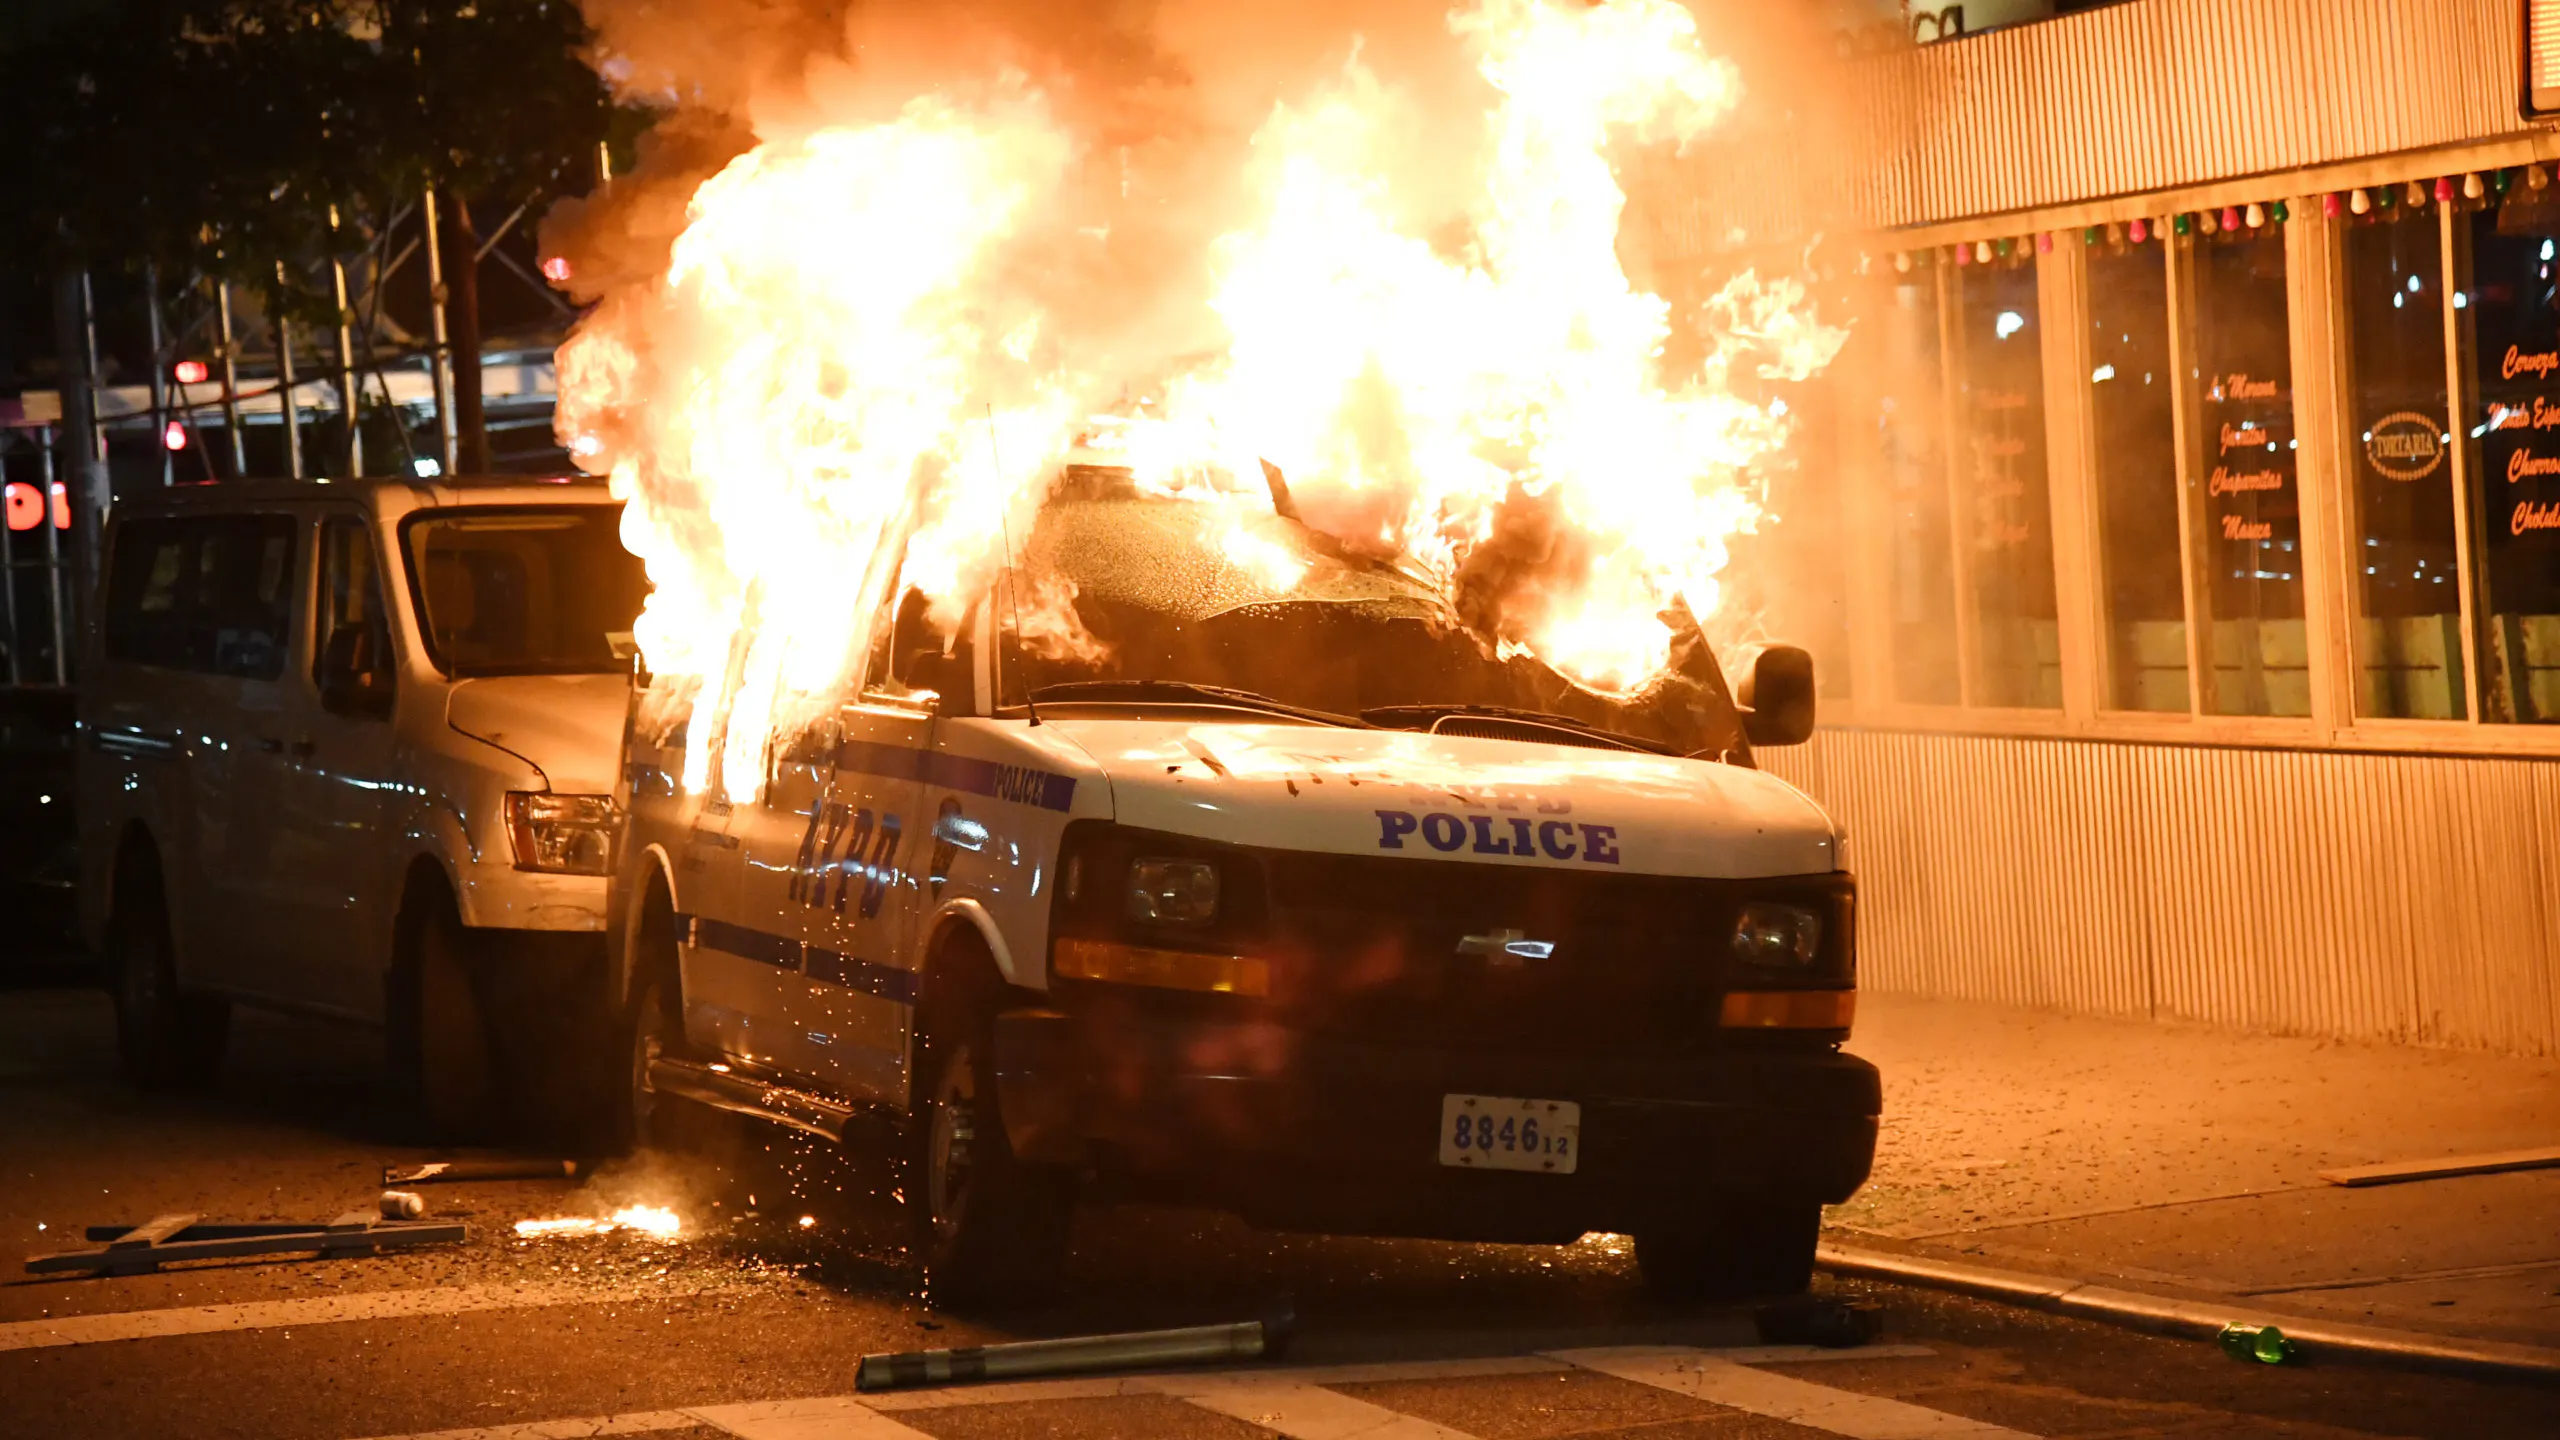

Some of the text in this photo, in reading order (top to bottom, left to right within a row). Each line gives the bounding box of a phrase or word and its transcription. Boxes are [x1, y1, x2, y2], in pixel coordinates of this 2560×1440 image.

[2502, 344, 2559, 380] Cerveza
[994, 763, 1047, 807] POLICE
[788, 799, 901, 920] NYPD
[1374, 809, 1620, 865] POLICE
